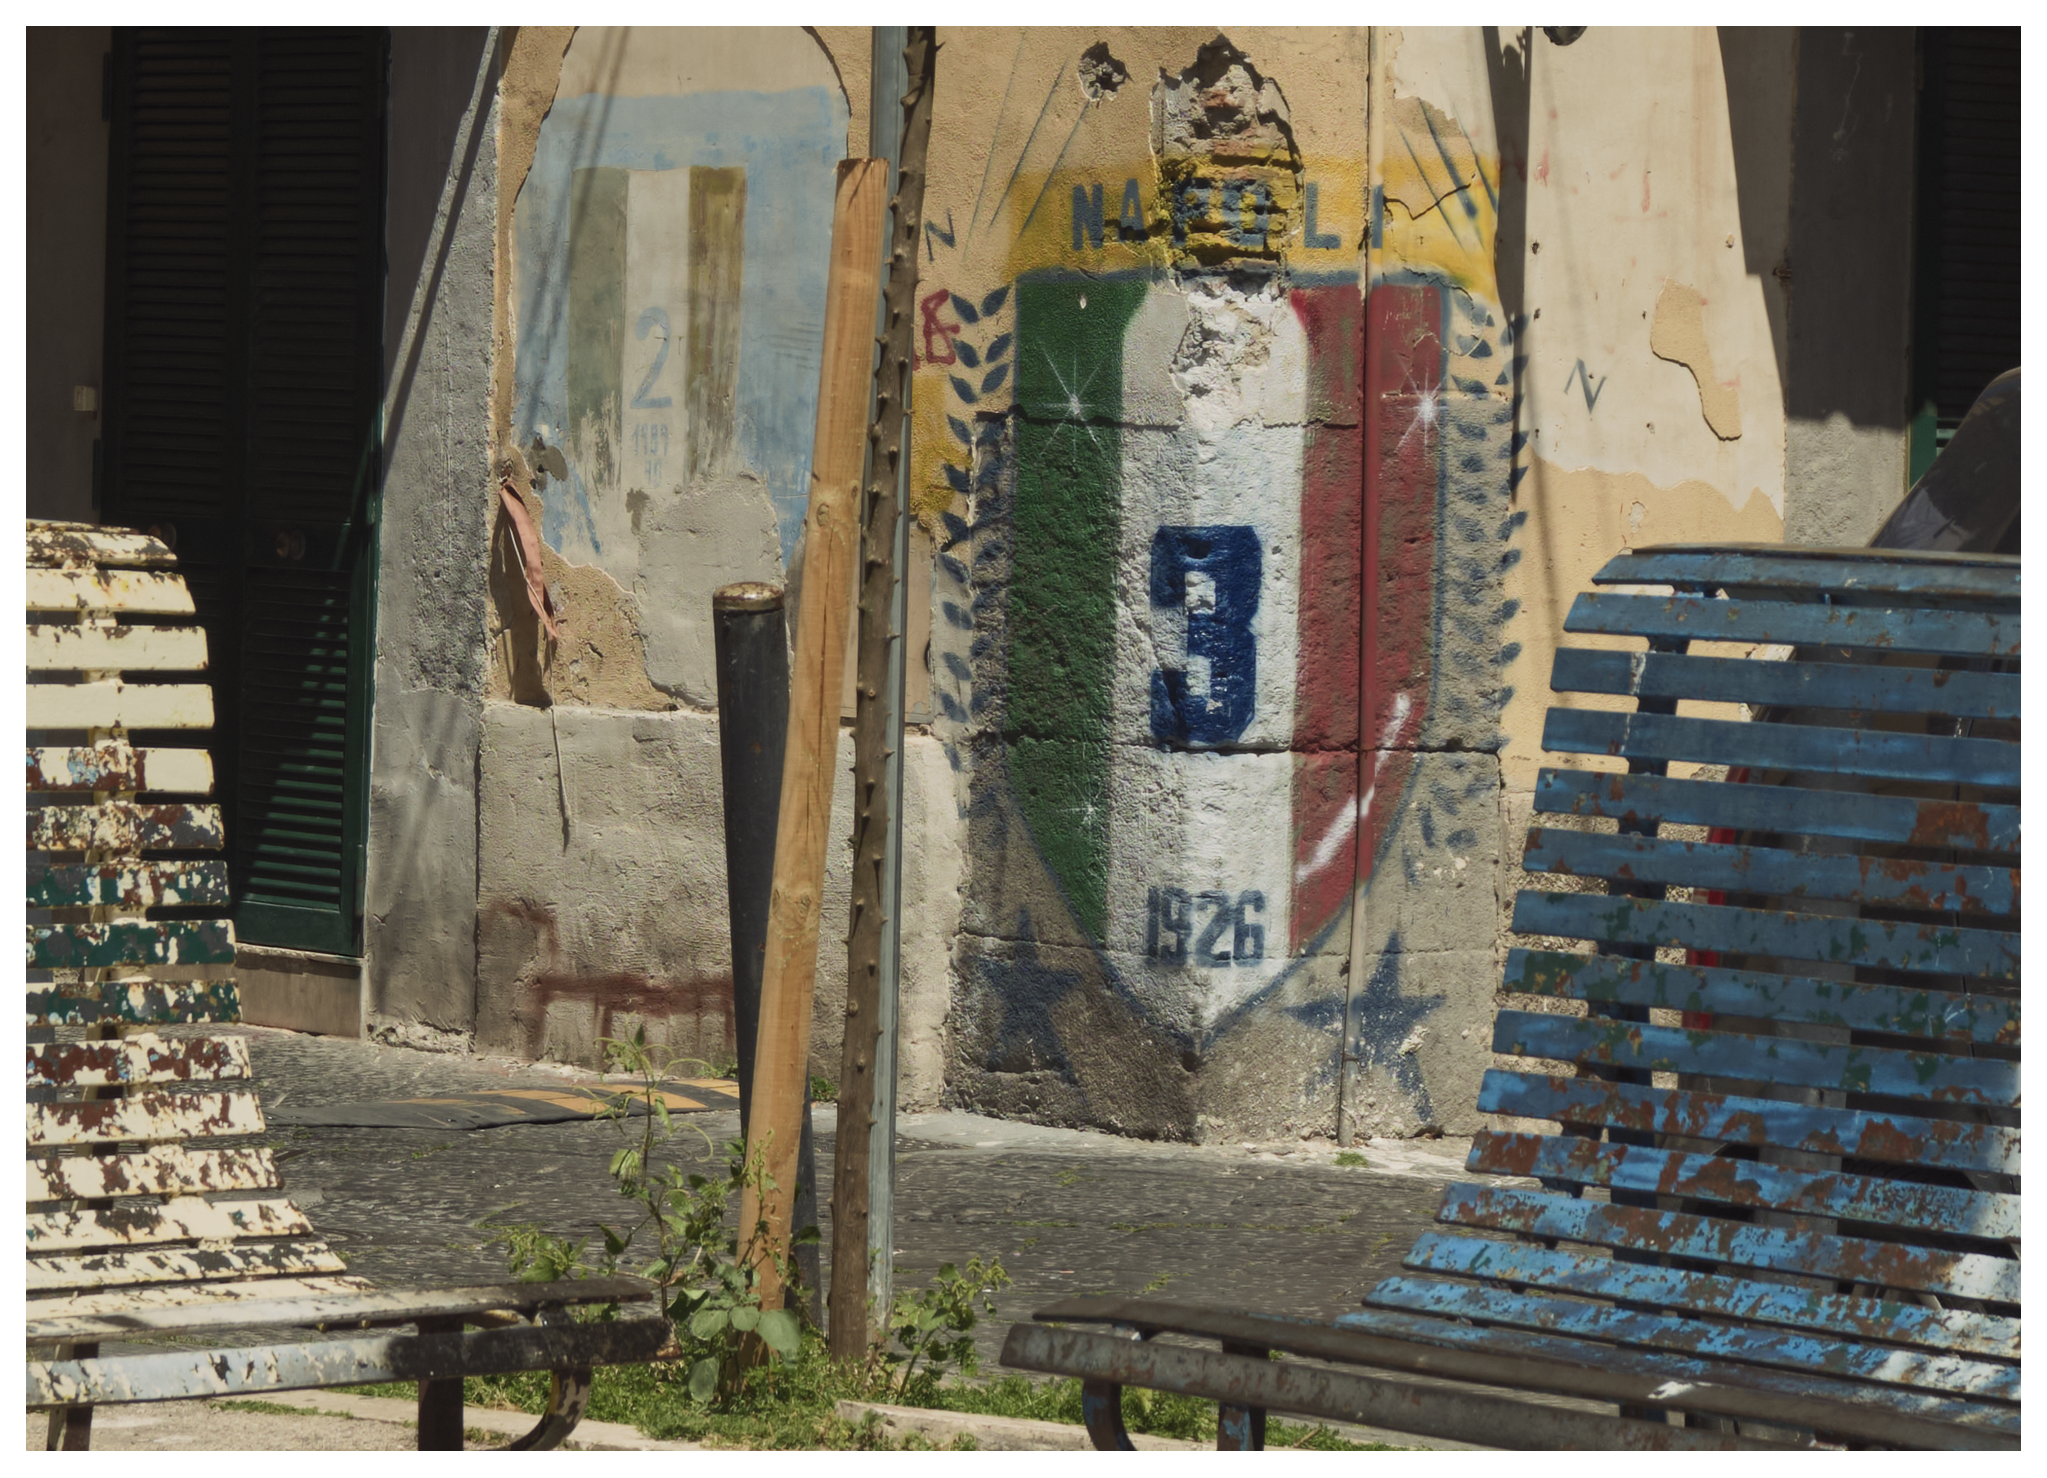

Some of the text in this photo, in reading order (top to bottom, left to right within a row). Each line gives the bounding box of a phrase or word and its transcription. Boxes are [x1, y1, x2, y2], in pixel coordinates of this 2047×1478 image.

[1072, 178, 1384, 251] NAPOLI
[630, 306, 673, 409] 2
[1150, 525, 1263, 746] 3
[1146, 885, 1267, 968] 1926
